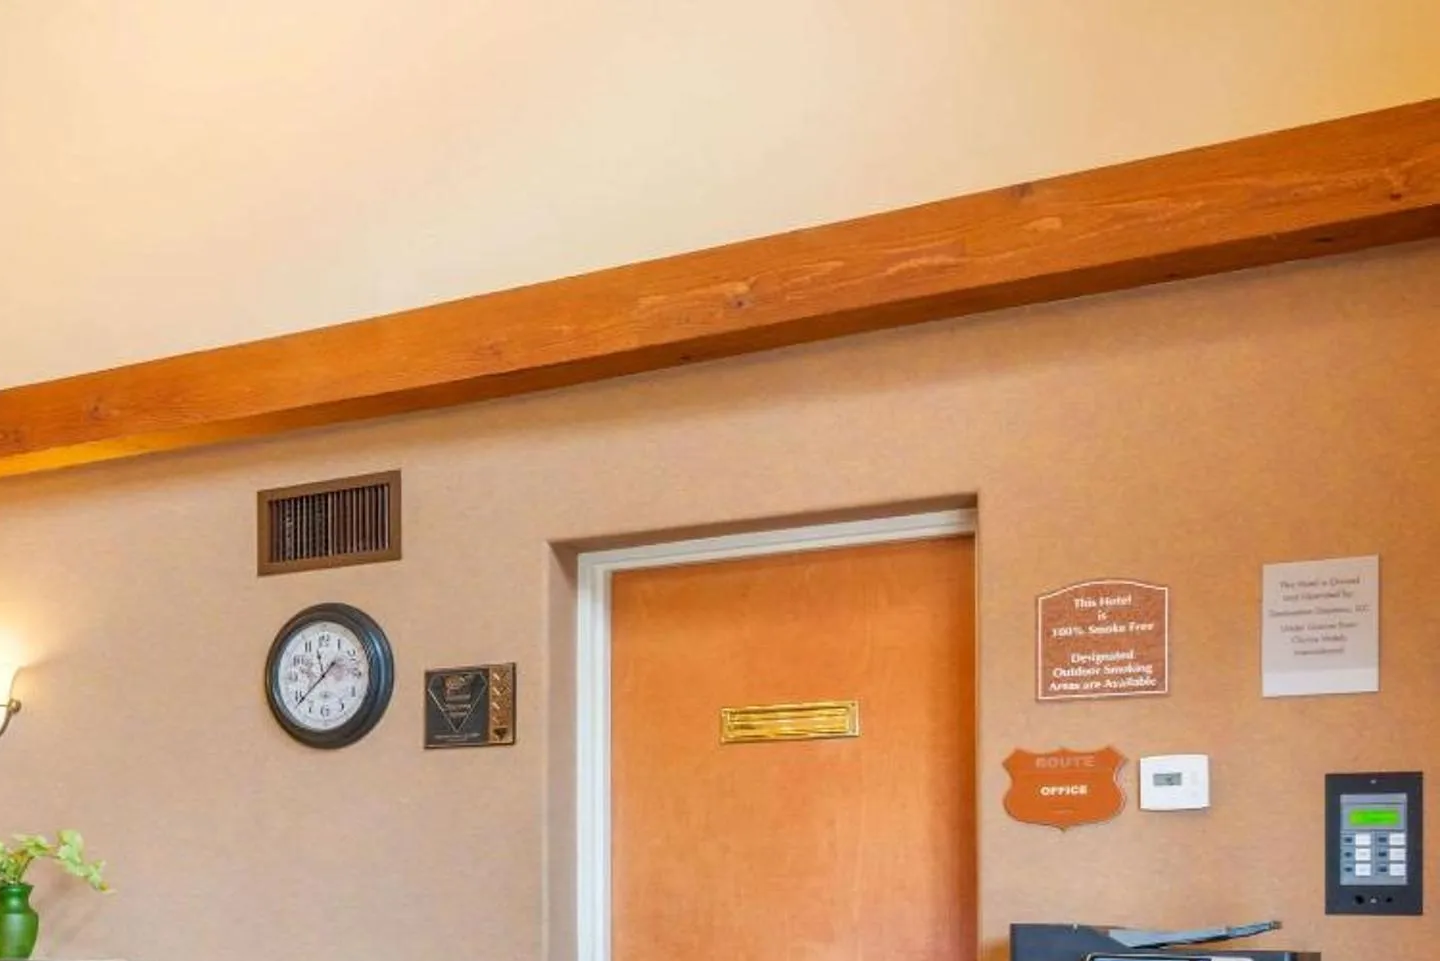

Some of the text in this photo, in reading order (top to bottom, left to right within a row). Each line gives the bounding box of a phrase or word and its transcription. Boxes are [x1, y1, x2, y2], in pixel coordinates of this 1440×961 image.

[1074, 594, 1132, 609] This Hotel
[1087, 623, 1126, 634] Smoke
[1128, 621, 1155, 632] Free
[1070, 650, 1135, 664] Designated
[1052, 664, 1154, 678] Outdoor Smoking
[1049, 681, 1081, 691] Areas
[1103, 676, 1157, 690] Available
[1035, 755, 1096, 769] ROUTE
[1039, 784, 1088, 797] OFFICE
